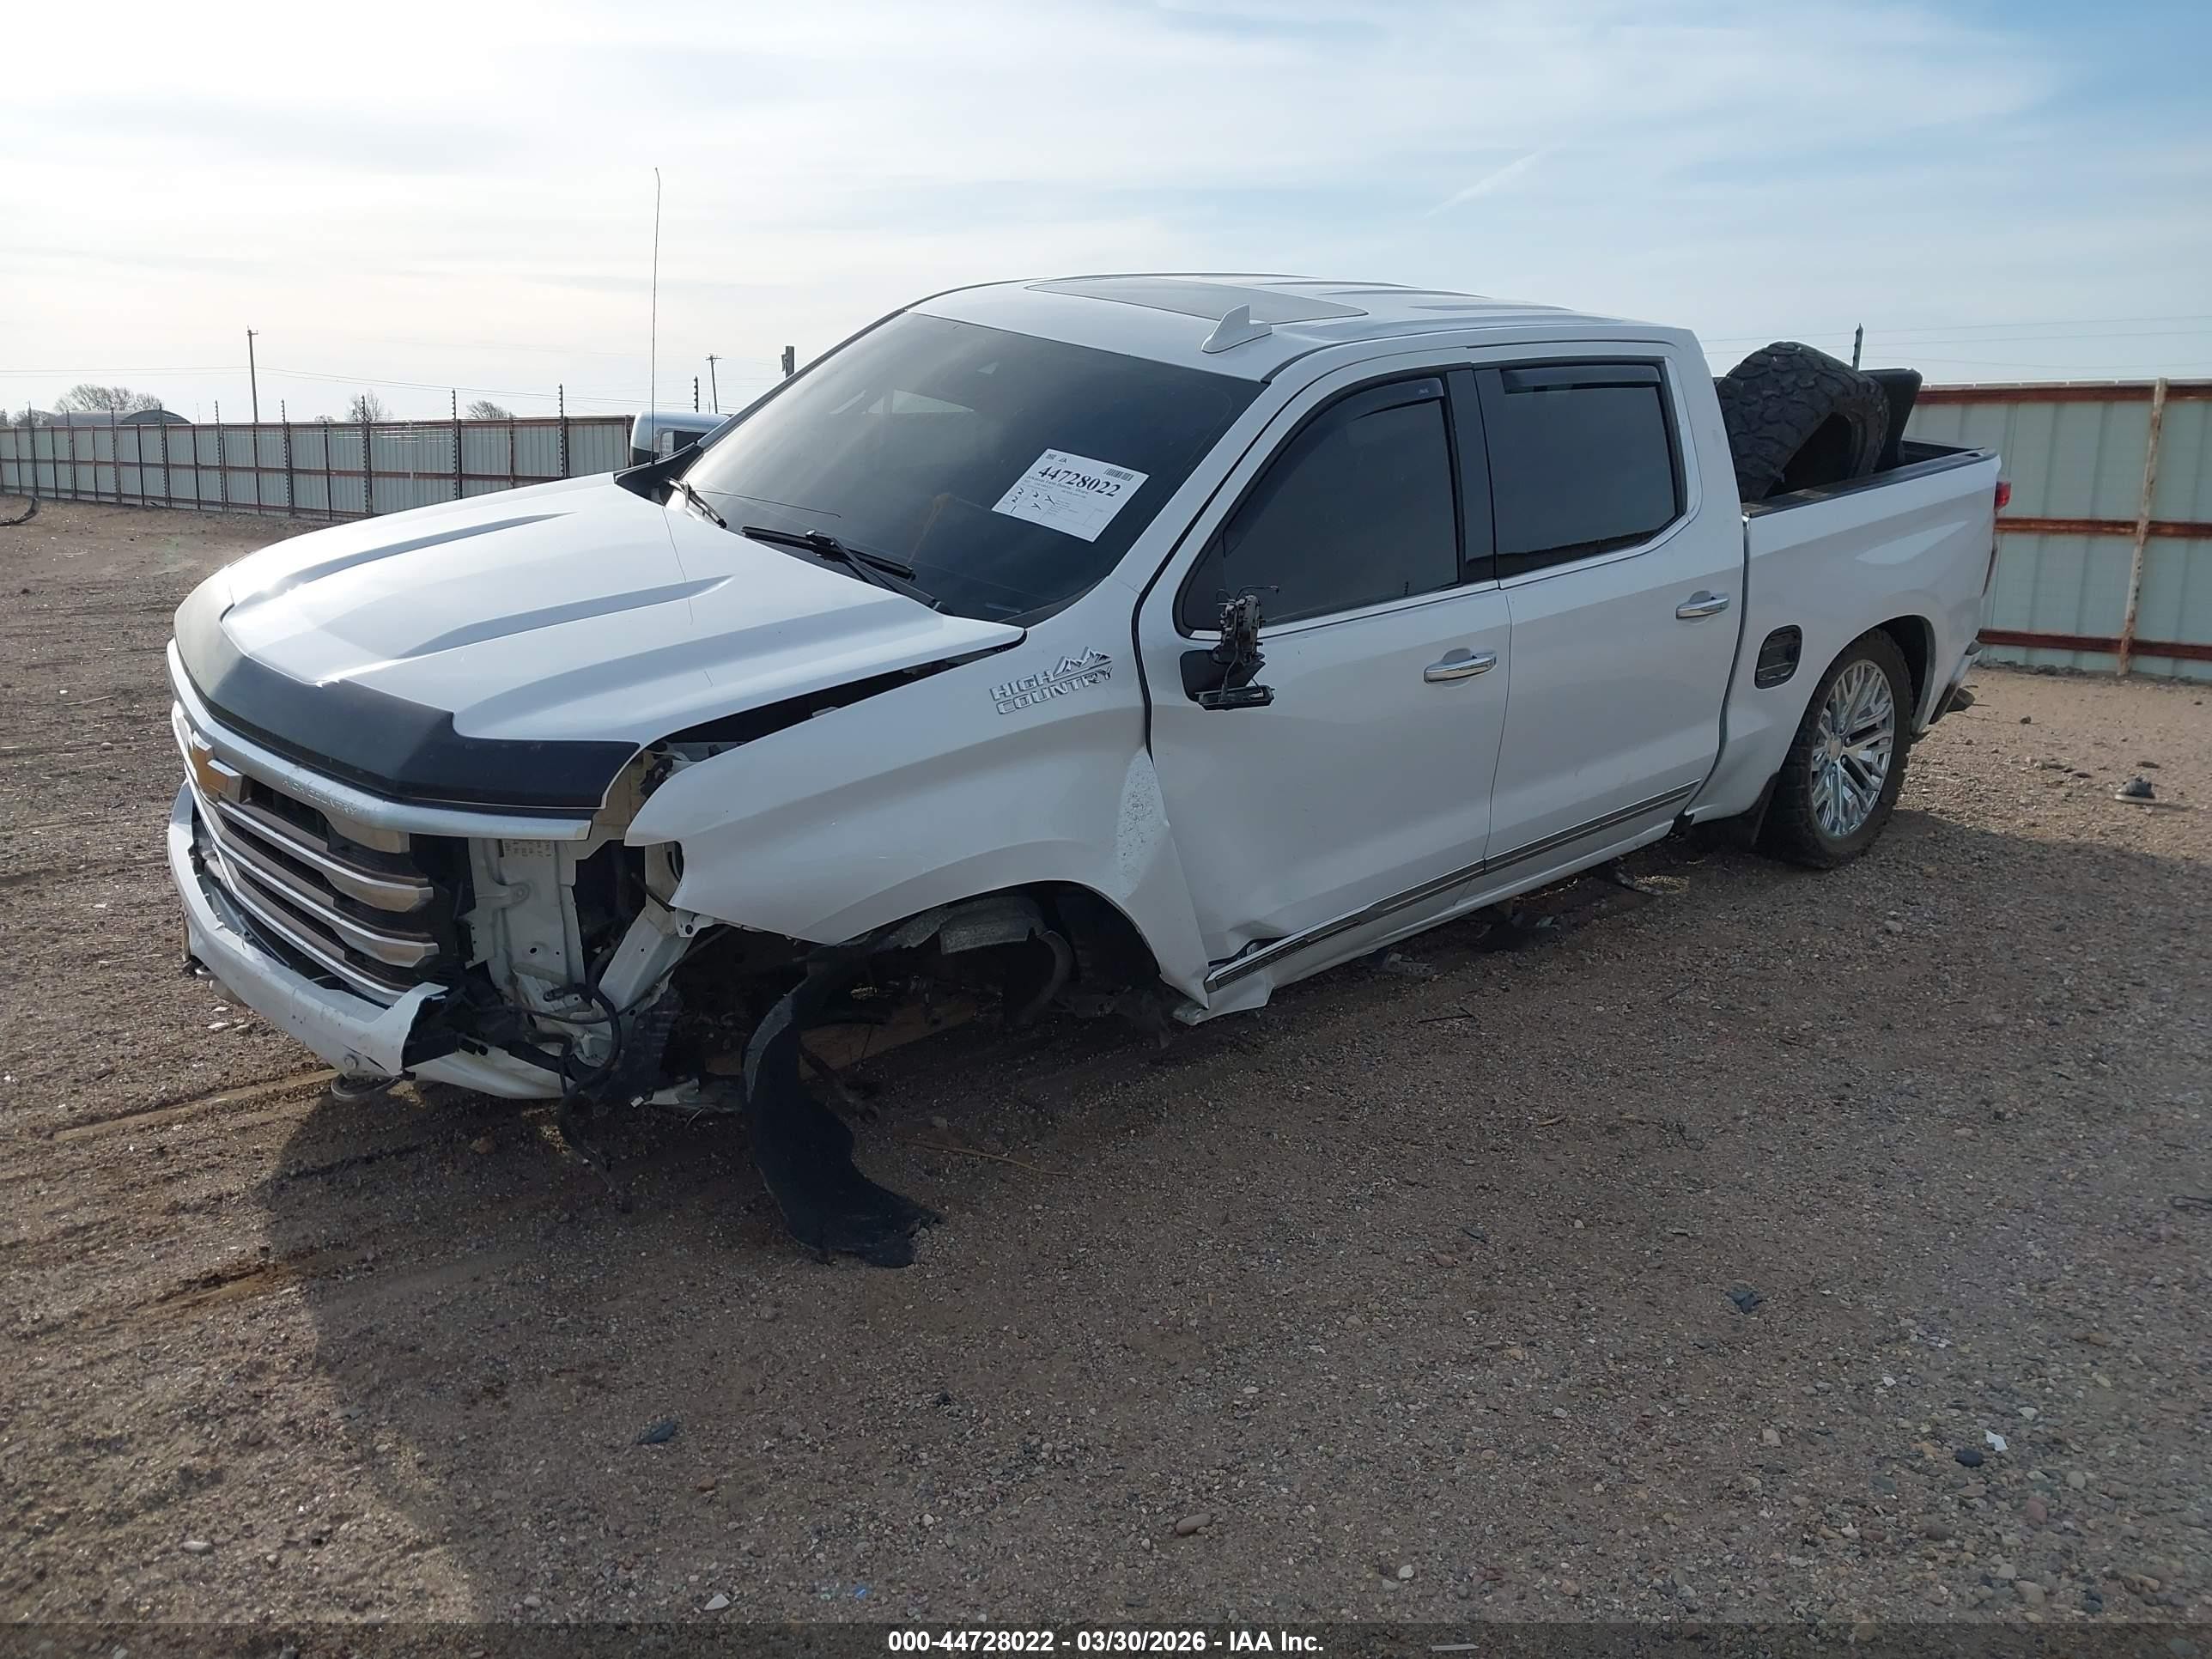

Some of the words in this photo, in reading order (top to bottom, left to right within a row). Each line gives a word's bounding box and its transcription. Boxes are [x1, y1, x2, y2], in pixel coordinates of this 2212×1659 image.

[1038, 465, 1121, 497] 44728022
[989, 670, 1054, 701] HIGH
[996, 666, 1114, 714] COUNTRY
